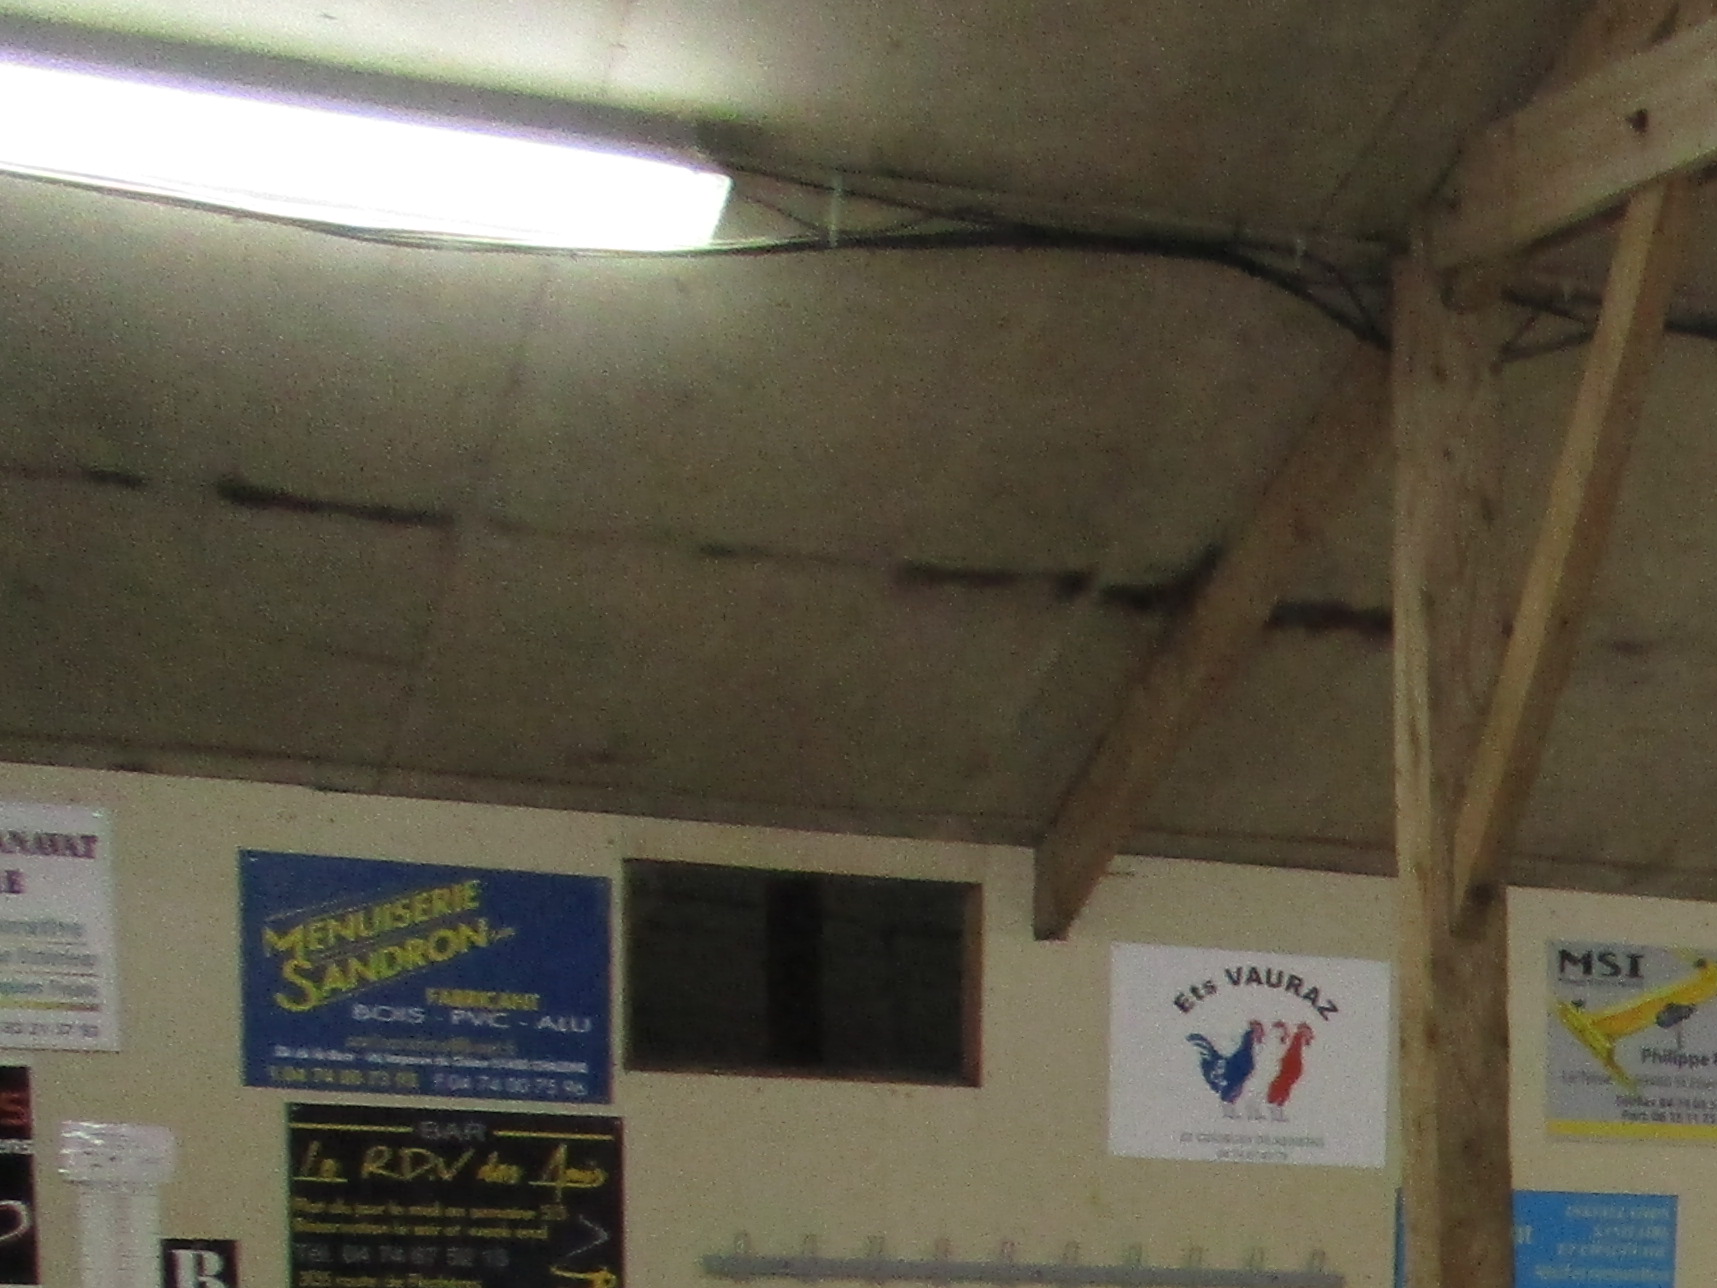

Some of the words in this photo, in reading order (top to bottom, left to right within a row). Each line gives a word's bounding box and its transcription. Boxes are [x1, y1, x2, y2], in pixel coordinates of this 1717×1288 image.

[261, 879, 482, 958] MENUISERIE
[274, 917, 489, 1012] SANDRON
[1557, 949, 1645, 980] MSI
[1173, 978, 1218, 1015] Ets
[1224, 966, 1340, 1022] VAURAZ
[352, 1005, 424, 1024] BOIS
[451, 1010, 509, 1030] PVC
[538, 1015, 591, 1033] ALU
[1640, 1048, 1710, 1069] Philippe
[416, 1119, 488, 1142] BAR
